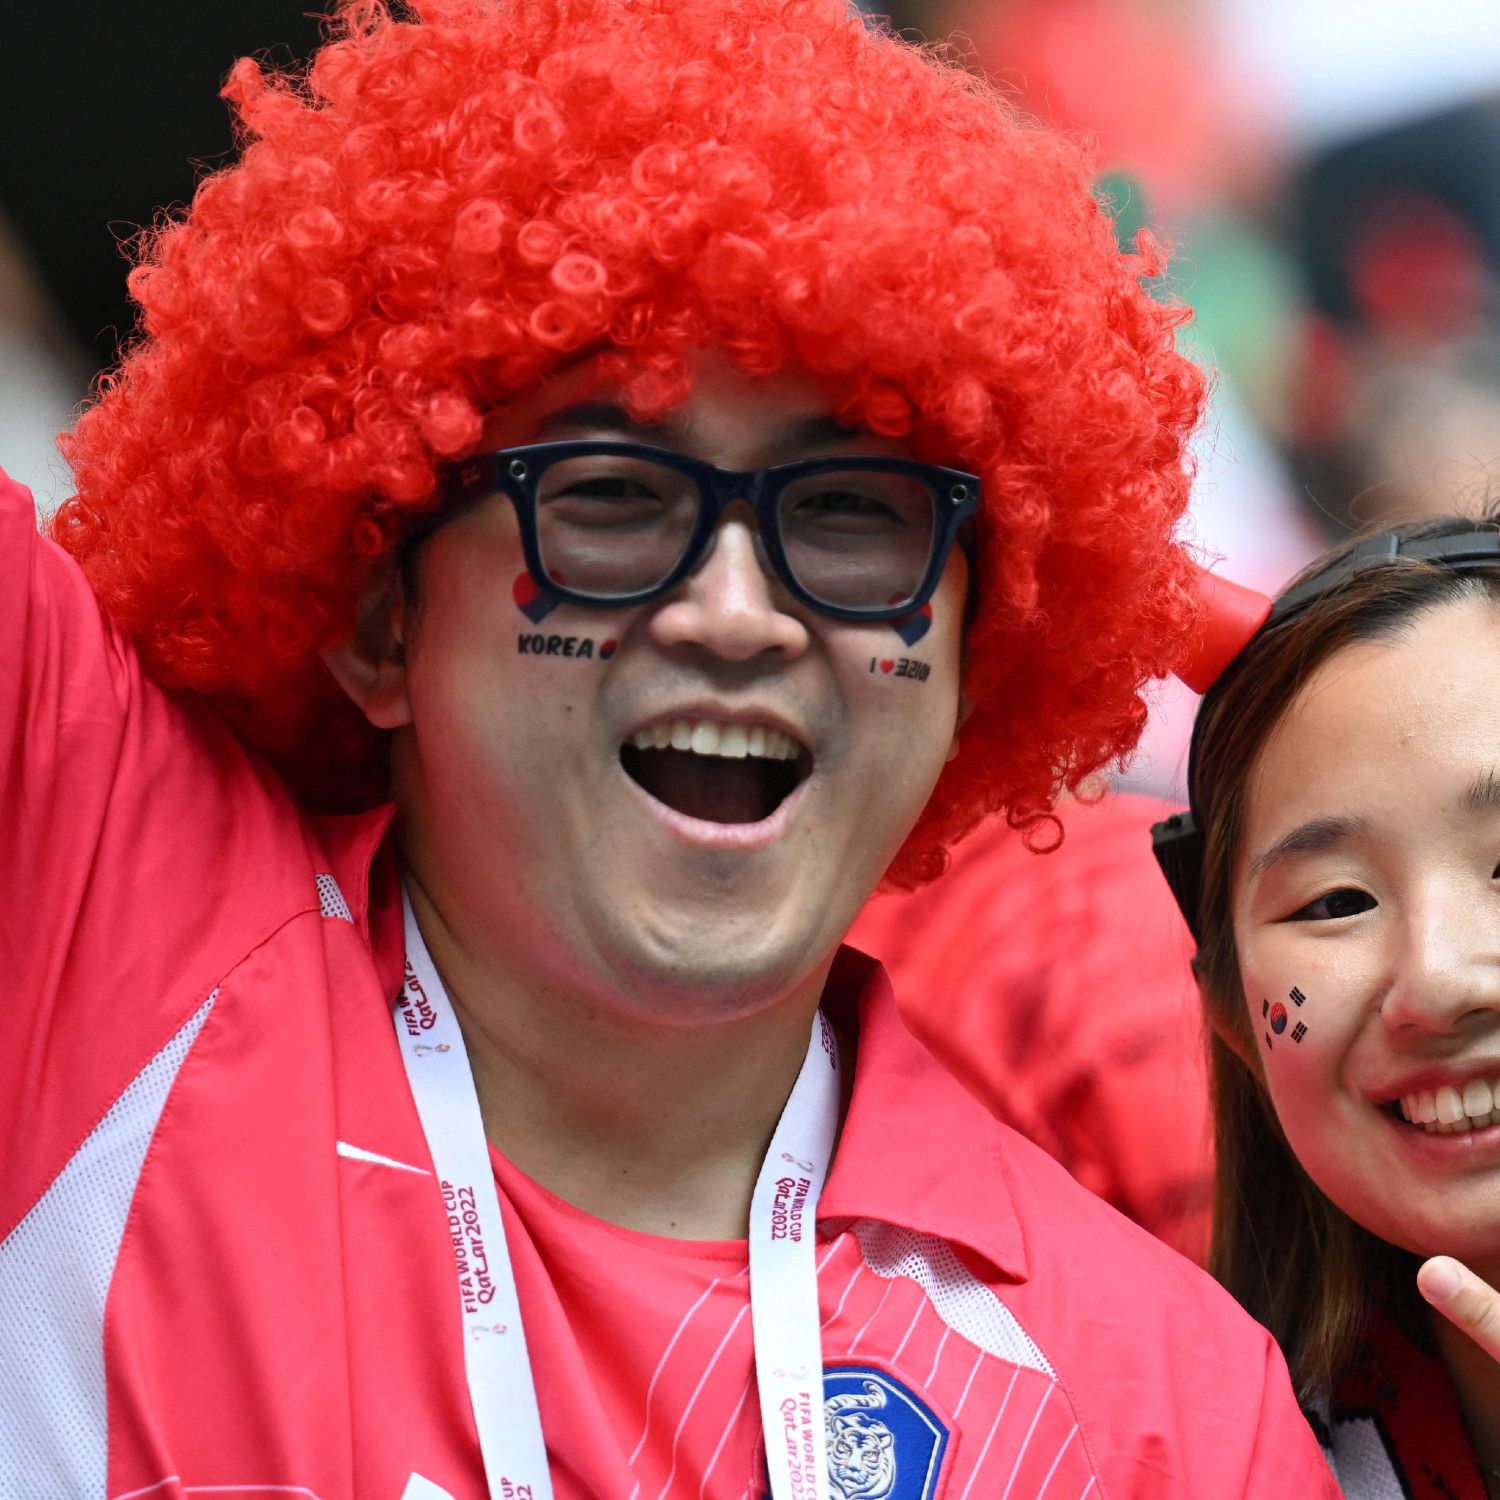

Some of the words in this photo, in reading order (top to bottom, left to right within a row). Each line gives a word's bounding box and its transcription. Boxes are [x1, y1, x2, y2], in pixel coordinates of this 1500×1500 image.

[517, 632, 594, 659] KOREA
[402, 1009, 421, 1036] FIFA
[441, 1180, 457, 1212] CUP
[795, 1177, 811, 1197] FIFA
[448, 1215, 470, 1275] WORLD
[789, 1222, 802, 1242] CUP
[461, 1276, 478, 1314] FIFA
[799, 1392, 812, 1425] FIFA
[801, 1428, 817, 1485] WORLD
[500, 1476, 515, 1500] UP
